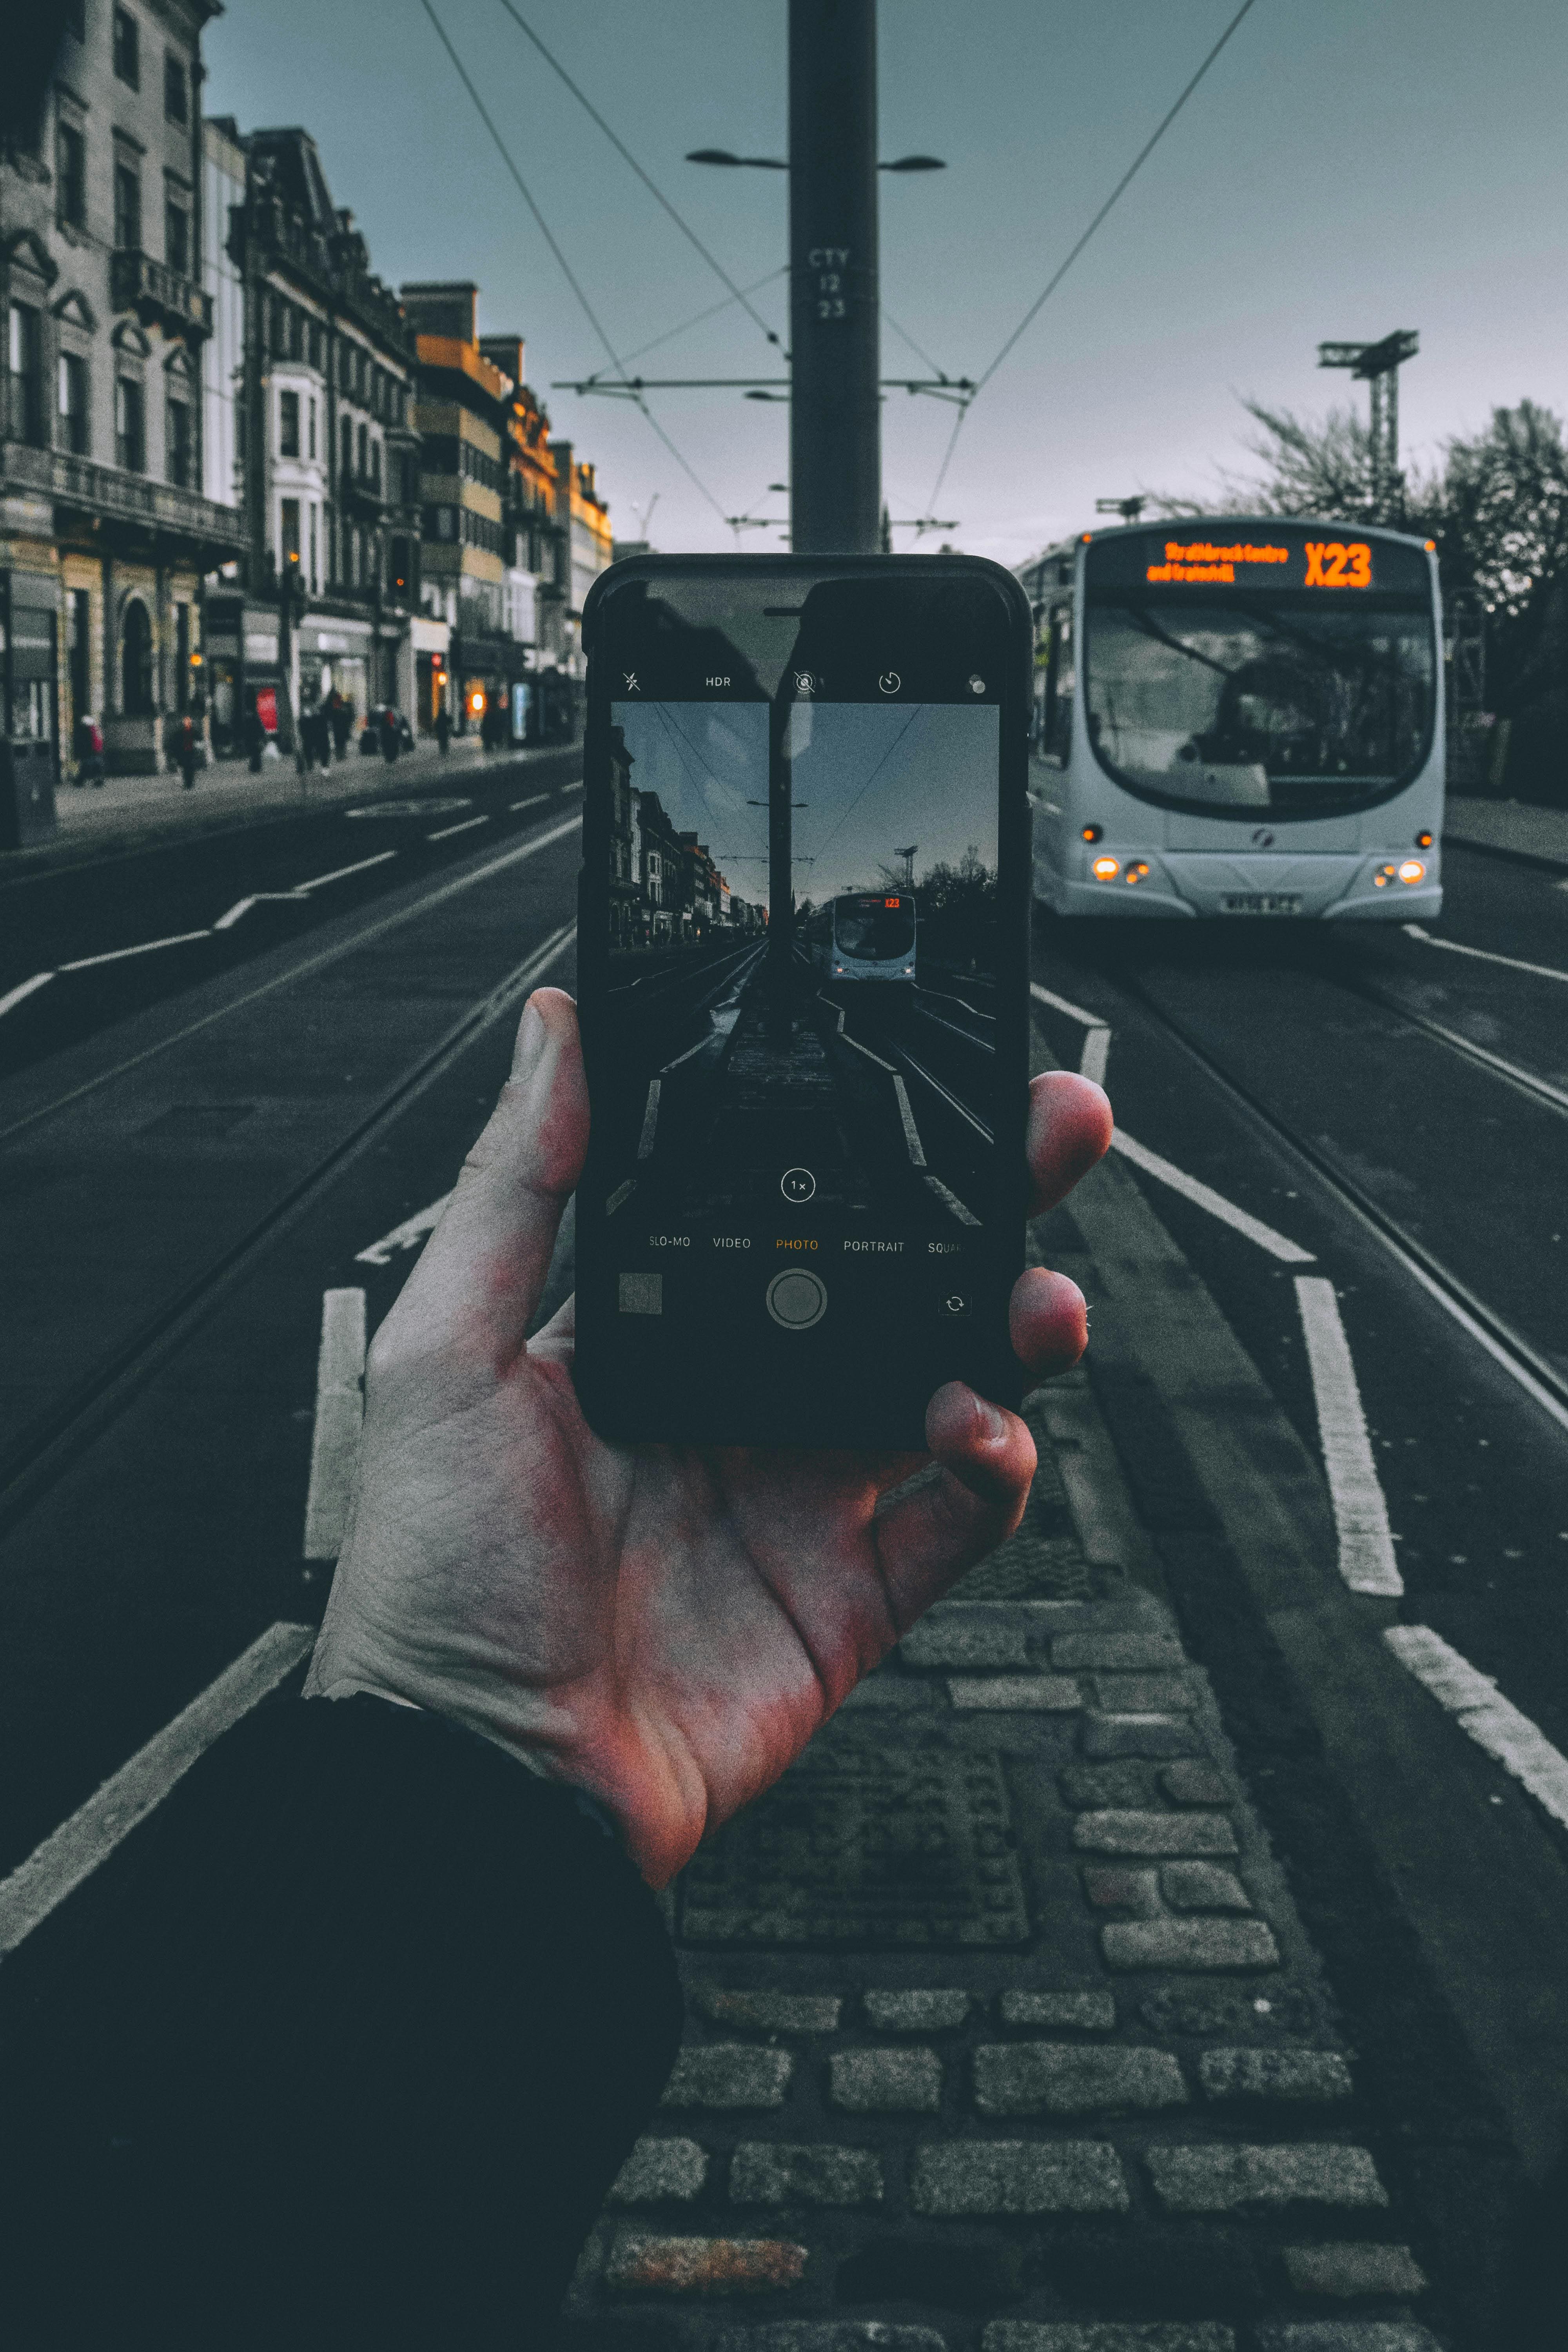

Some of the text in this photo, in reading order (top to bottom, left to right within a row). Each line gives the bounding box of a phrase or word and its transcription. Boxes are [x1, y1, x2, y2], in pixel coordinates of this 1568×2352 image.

[809, 248, 849, 267] CTY
[1304, 542, 1371, 587] X23
[706, 677, 731, 687] HDR
[650, 1236, 690, 1247] SLO-MO
[713, 1238, 751, 1248] VIDEO
[776, 1240, 818, 1250] PHOTO
[844, 1241, 904, 1252] PORTRAIT
